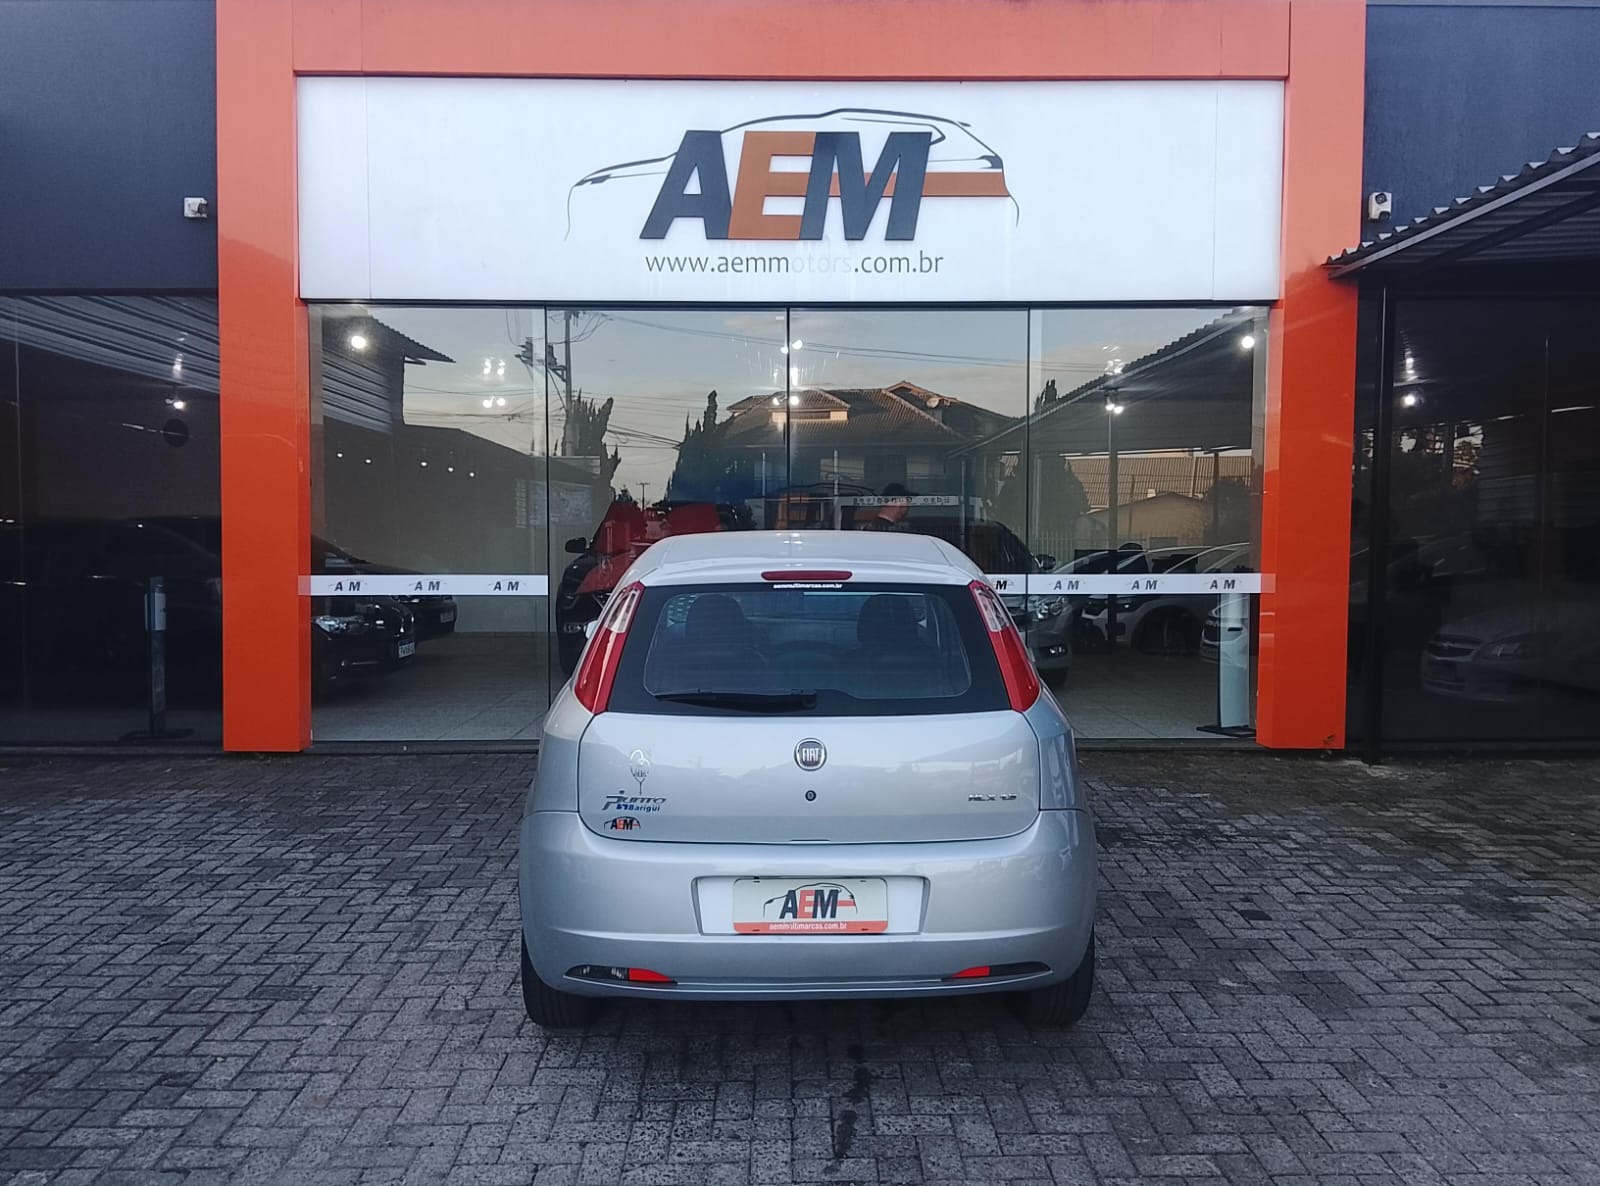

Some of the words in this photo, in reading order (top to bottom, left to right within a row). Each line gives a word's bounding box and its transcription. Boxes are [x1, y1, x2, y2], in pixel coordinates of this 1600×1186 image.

[640, 130, 932, 240] AEM
[645, 250, 944, 273] www.aemmotors.com.br
[802, 748, 819, 762] FIAT
[610, 818, 633, 830] AEM
[779, 889, 839, 919] AEM
